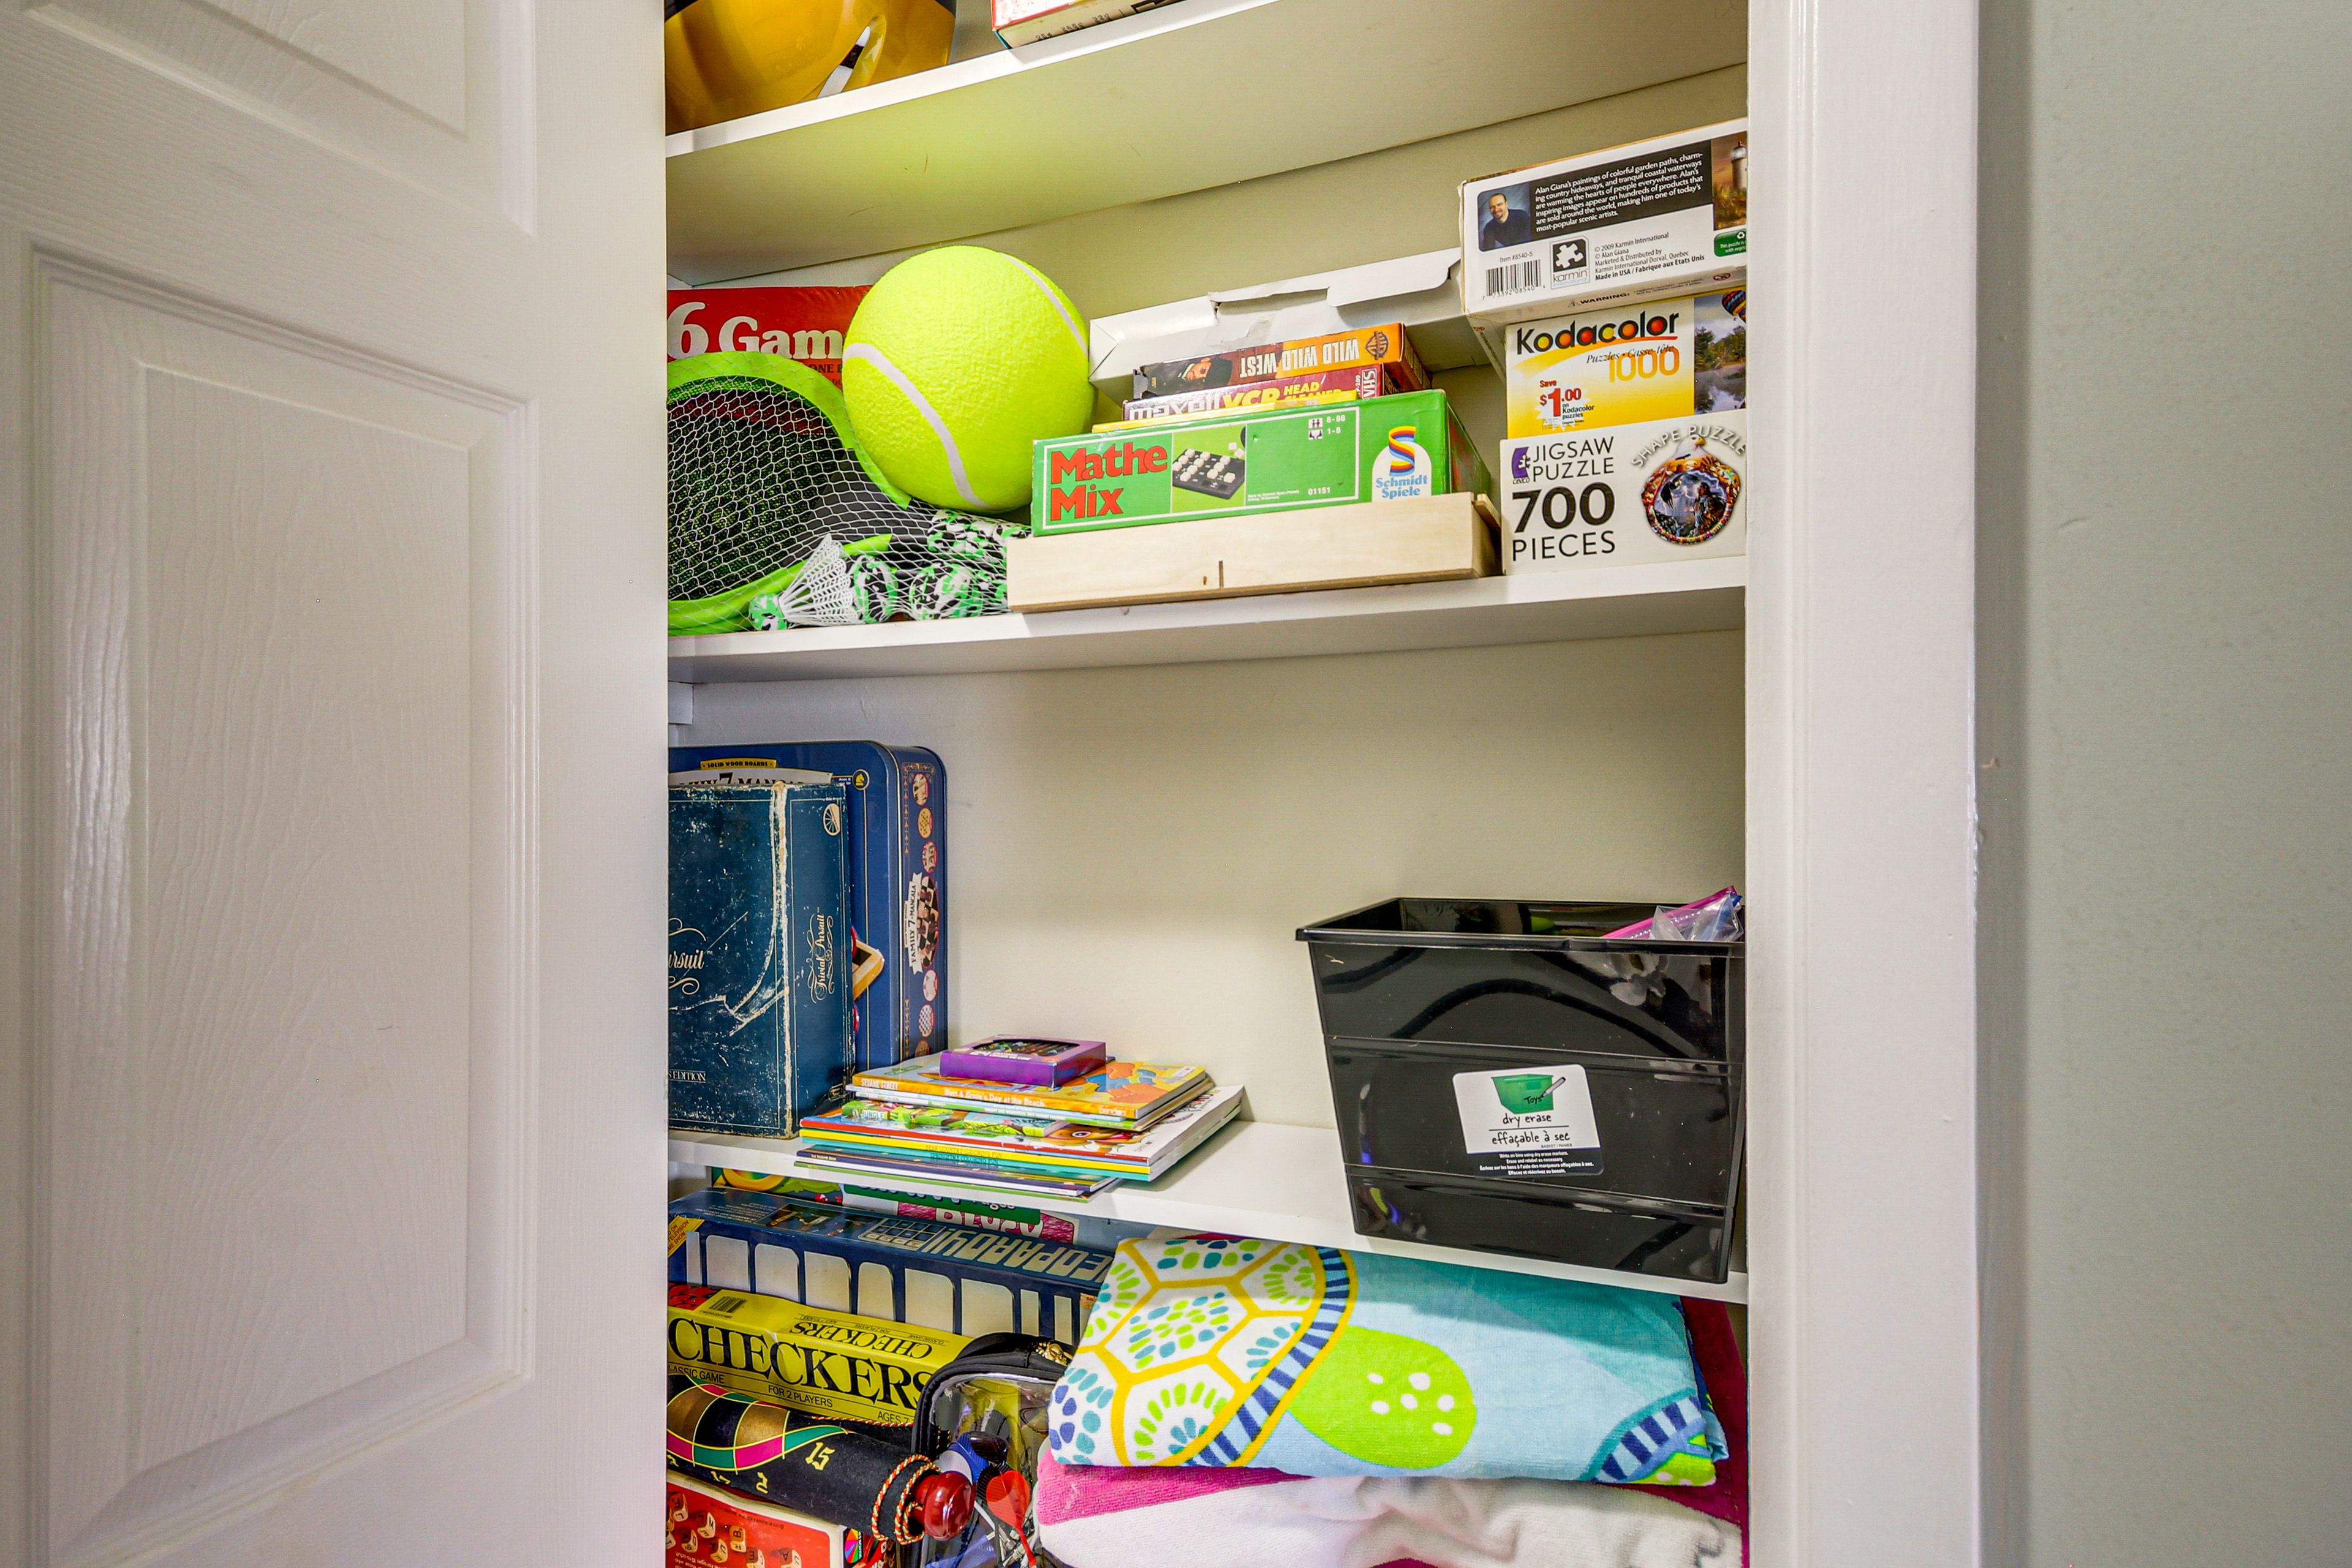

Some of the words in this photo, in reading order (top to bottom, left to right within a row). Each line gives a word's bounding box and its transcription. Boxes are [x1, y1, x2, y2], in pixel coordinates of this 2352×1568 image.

[1546, 190, 1570, 199] country
[1570, 183, 1604, 194] hideaways,
[1619, 172, 1643, 183] tranquil
[1645, 167, 1667, 178] coastal
[1667, 160, 1702, 173] waterways
[1550, 181, 1572, 190] Giana's
[1572, 176, 1600, 187] paintings
[1610, 166, 1634, 178] colorful
[1635, 162, 1658, 174] garden
[1659, 157, 1678, 168] paths,
[1679, 153, 1703, 162] charm-
[1536, 207, 1562, 217] inspiring
[1562, 202, 1585, 212] images
[1585, 197, 1608, 208] appear
[1619, 187, 1649, 199] hundreds
[1659, 179, 1689, 192] products
[1690, 175, 1703, 184] that
[1547, 197, 1573, 207] warming
[1585, 189, 1605, 198] hearts
[1614, 182, 1637, 192] people
[1638, 175, 1678, 188] everywhere.
[1679, 169, 1698, 178] Alan's
[1547, 214, 1561, 222] sold
[1561, 209, 1584, 219] around
[1596, 202, 1616, 211] world,
[1617, 198, 1640, 208] making
[1642, 194, 1654, 203] him
[1677, 184, 1701, 194] today's
[1536, 219, 1578, 232] most-popular
[1578, 214, 1598, 223] scenic
[1599, 210, 1618, 219] artists.
[1615, 239, 1634, 249] Karmin
[1635, 232, 1669, 244] International
[1512, 251, 1533, 261] #8540-5
[1595, 256, 1619, 266] Marketed
[1626, 249, 1654, 261] Distributed
[1595, 264, 1613, 274] Karmin
[1615, 258, 1648, 270] International
[1649, 254, 1667, 265] Dorval,
[1669, 250, 1689, 260] Quebec
[1553, 269, 1587, 283] karmin
[1595, 273, 1611, 281] Made
[1635, 262, 1662, 274] Fabrique
[1675, 257, 1690, 266] Etats
[1580, 292, 1630, 305] WARNING:
[668, 302, 709, 360] 6
[1517, 311, 1679, 355] Kodacolor
[1282, 345, 1317, 371] WILD
[1322, 339, 1360, 364] WILD
[1239, 352, 1278, 377] WEST
[1609, 347, 1680, 382] 1000
[1284, 382, 1321, 396] HEAD
[1362, 369, 1376, 400] VHS
[1222, 386, 1281, 410] VCR
[1540, 388, 1581, 417] $1.00
[1562, 405, 1595, 413] Kodacolor
[1533, 435, 1614, 462] JIGSAW
[1632, 428, 1680, 468] SHAPE
[1051, 442, 1167, 484] Mathe
[1533, 457, 1615, 482] PUZZLE
[1308, 486, 1330, 496] 01151
[1376, 474, 1428, 488] Schmidt
[1381, 486, 1420, 500] Spiele
[1050, 485, 1123, 521] Mix
[1512, 482, 1615, 533] 700
[1513, 530, 1615, 562] PIECES
[814, 913, 827, 957] Pursuit
[815, 957, 827, 1000] Trivial
[673, 1071, 706, 1081] EDITION
[861, 1078, 880, 1089] SESAME
[880, 1080, 899, 1090] STREET
[944, 1088, 959, 1097] Bert
[965, 1091, 988, 1101] Ernie's
[989, 1093, 1002, 1103] Day
[1011, 1096, 1022, 1105] the
[1024, 1098, 1046, 1107] Beach
[1524, 1095, 1542, 1104] Toys
[862, 1109, 885, 1120] JUNGLE
[1502, 1113, 1520, 1128] dry
[1525, 1114, 1551, 1123] erase
[1492, 1131, 1540, 1148] effaçable
[1544, 1130, 1550, 1142] à
[1555, 1132, 1570, 1141] sec
[922, 1226, 1114, 1284] EOPARDY!
[790, 1321, 933, 1360] CHECKERS
[699, 1371, 725, 1384] GAME
[767, 1384, 785, 1395] FOR
[786, 1388, 793, 1398] 2
[793, 1389, 833, 1408] PLAYERS
[878, 1411, 902, 1424] AGES
[805, 1442, 836, 1470] 15
[756, 1472, 768, 1494] 2
